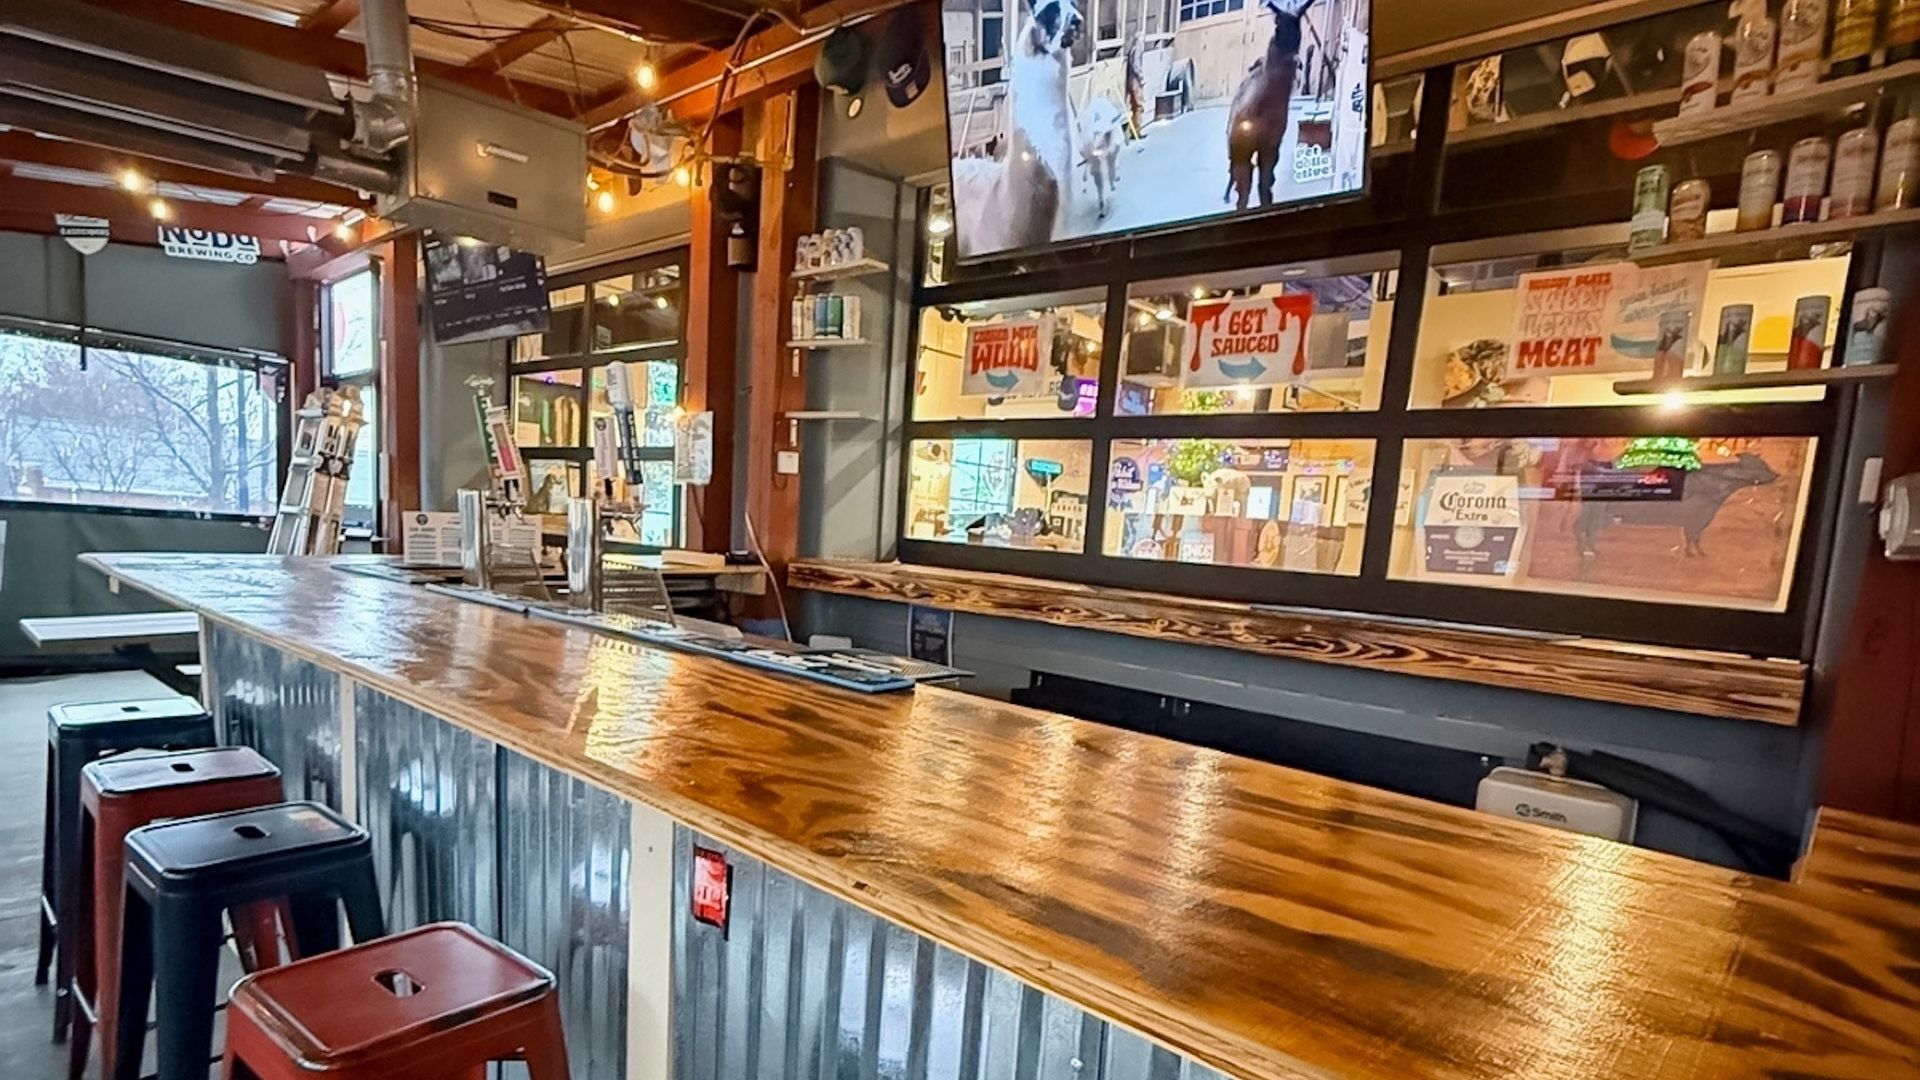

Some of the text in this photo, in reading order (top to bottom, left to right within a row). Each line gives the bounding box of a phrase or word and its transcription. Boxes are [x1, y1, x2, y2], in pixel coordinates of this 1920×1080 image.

[169, 246, 232, 259] BREWING
[1229, 308, 1267, 335] GET
[1211, 333, 1279, 357] SAUCED
[1516, 337, 1602, 369] MEAT
[971, 342, 1039, 375] WOOD
[1440, 491, 1507, 513] Corona
[1456, 509, 1488, 521] Extra
[1532, 808, 1567, 823] Smith
